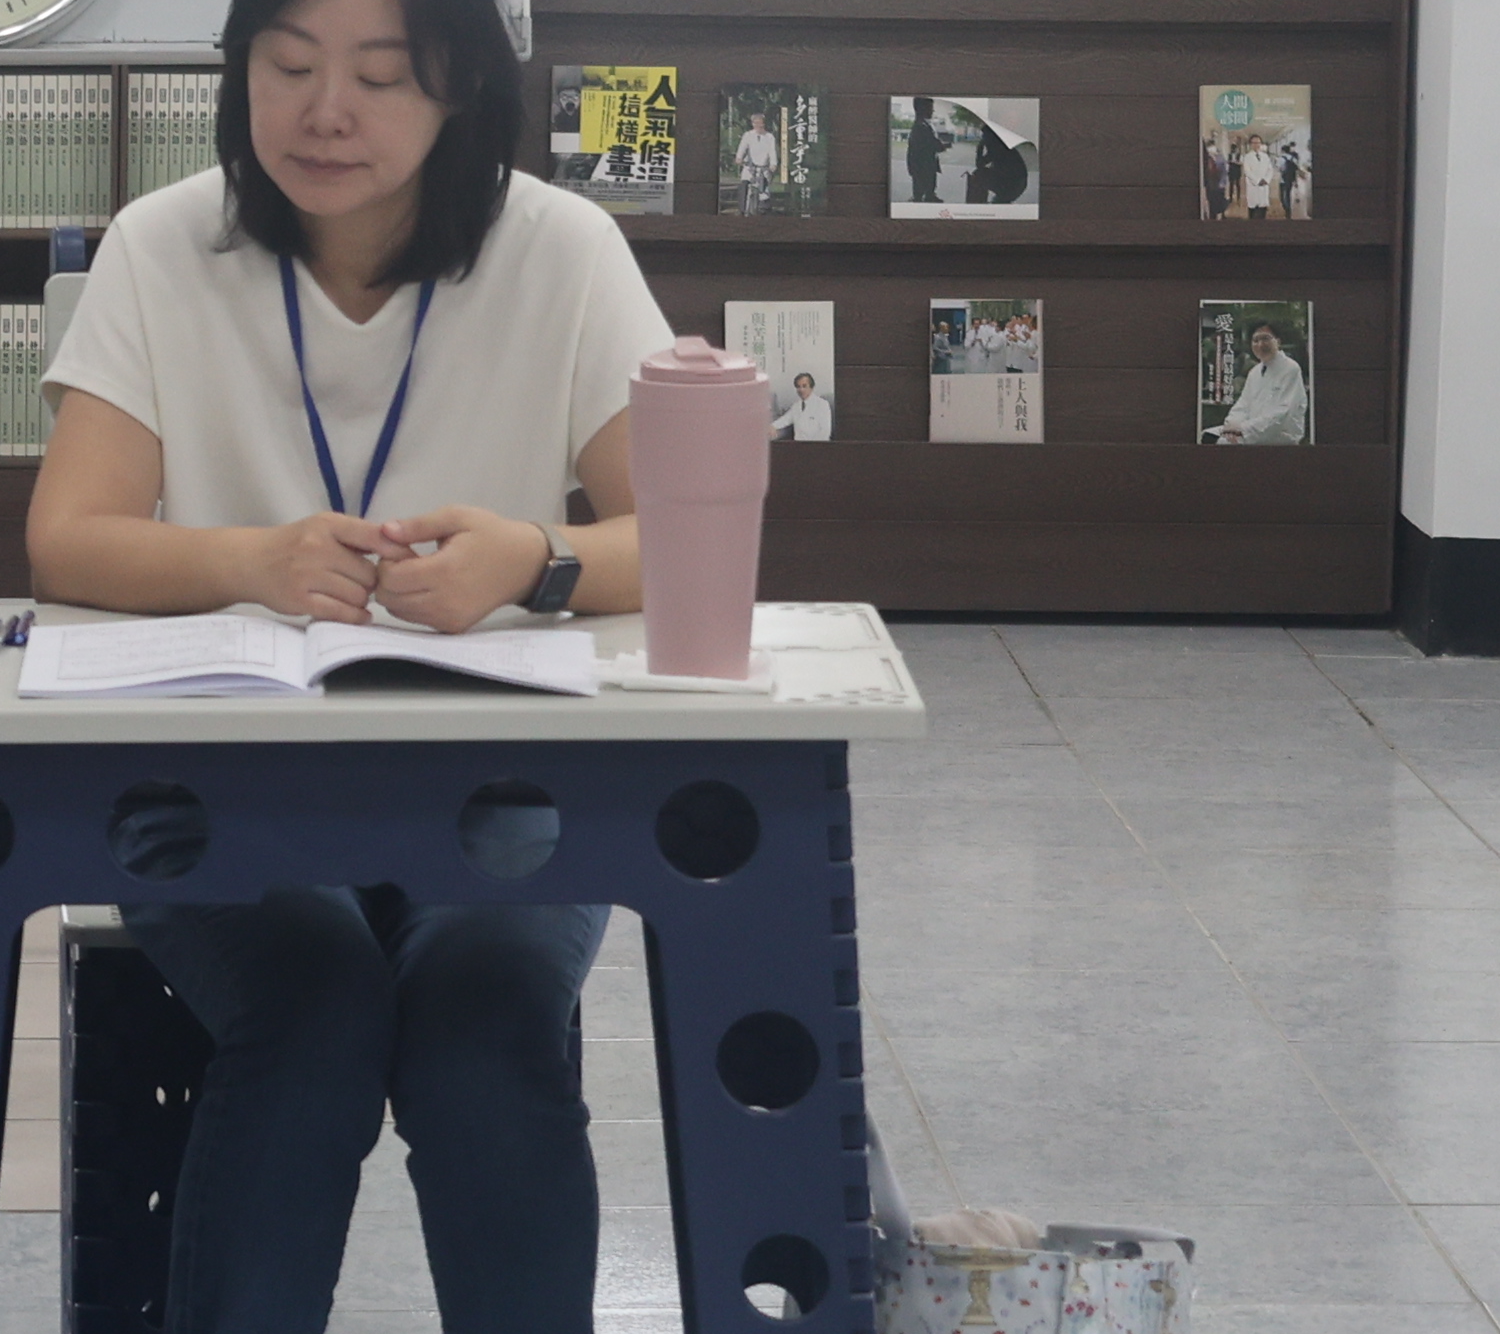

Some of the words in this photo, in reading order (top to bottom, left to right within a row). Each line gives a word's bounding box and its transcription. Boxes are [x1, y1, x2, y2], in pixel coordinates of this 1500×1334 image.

[788, 95, 809, 184] 多重宇宙
[1014, 377, 1028, 432] 上人與我
